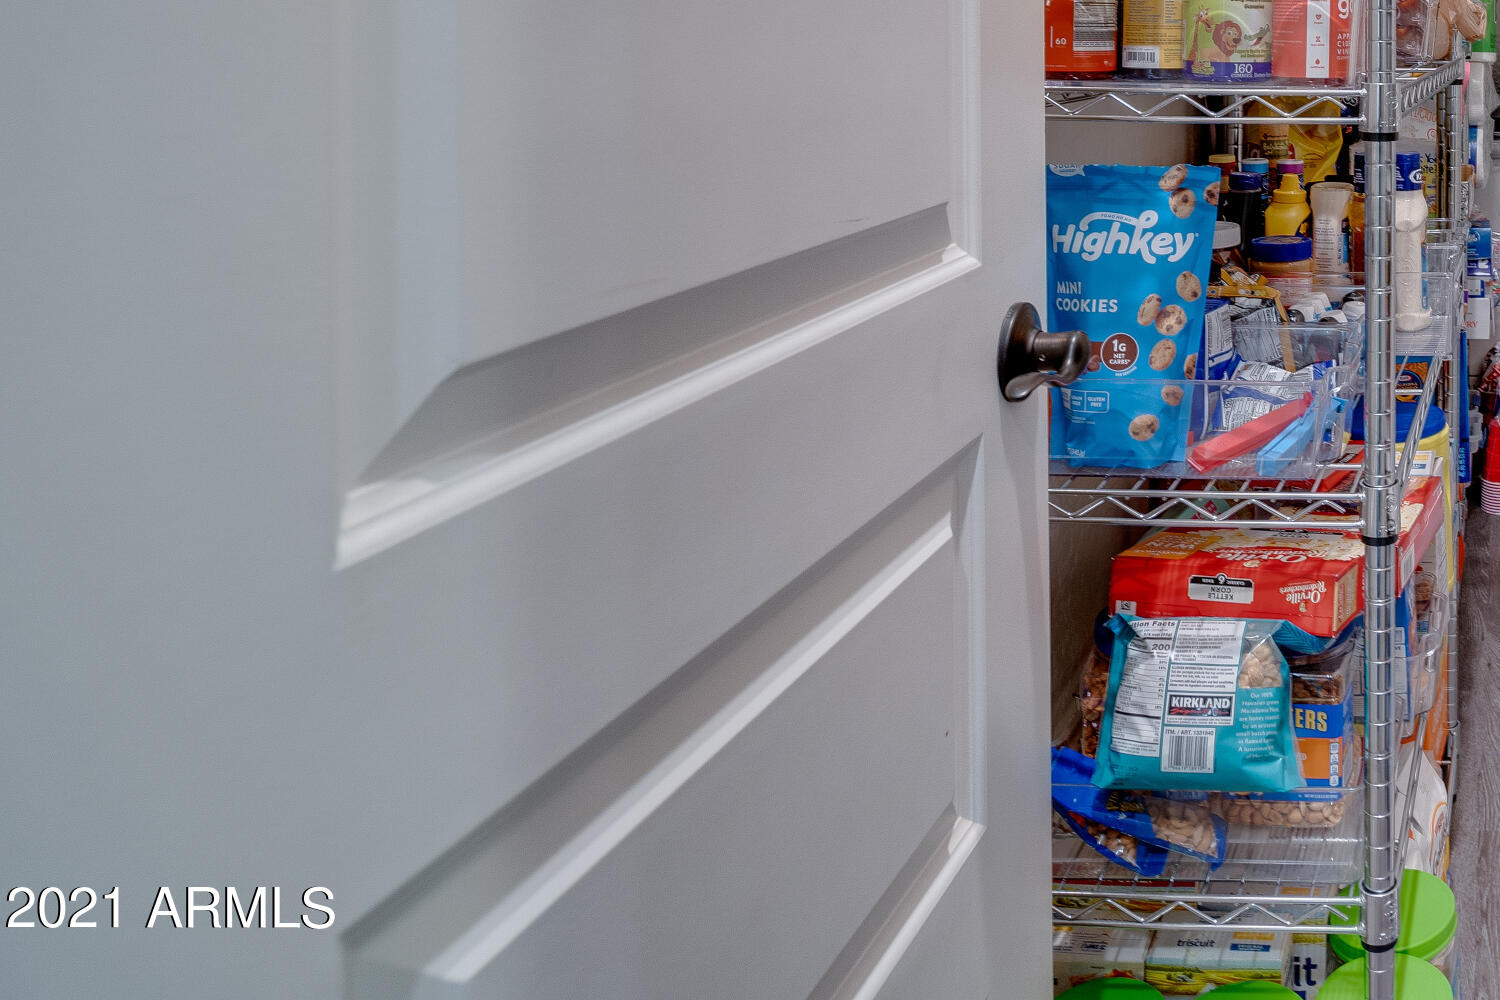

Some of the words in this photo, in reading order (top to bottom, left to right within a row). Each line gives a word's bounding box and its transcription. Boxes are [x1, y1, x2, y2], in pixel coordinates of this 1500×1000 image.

[1055, 37, 1067, 45] 60
[1233, 63, 1253, 74] 160
[1056, 281, 1082, 294] MINI
[1056, 298, 1118, 313] COOKIES
[1214, 552, 1308, 564] Orville
[1210, 586, 1232, 594] CORN
[1279, 580, 1327, 596] Redenbacher's
[1207, 592, 1234, 600] KETTLE
[1285, 591, 1321, 605] Orville
[1151, 643, 1171, 651] 200
[1171, 696, 1231, 709] KIRKLAND
